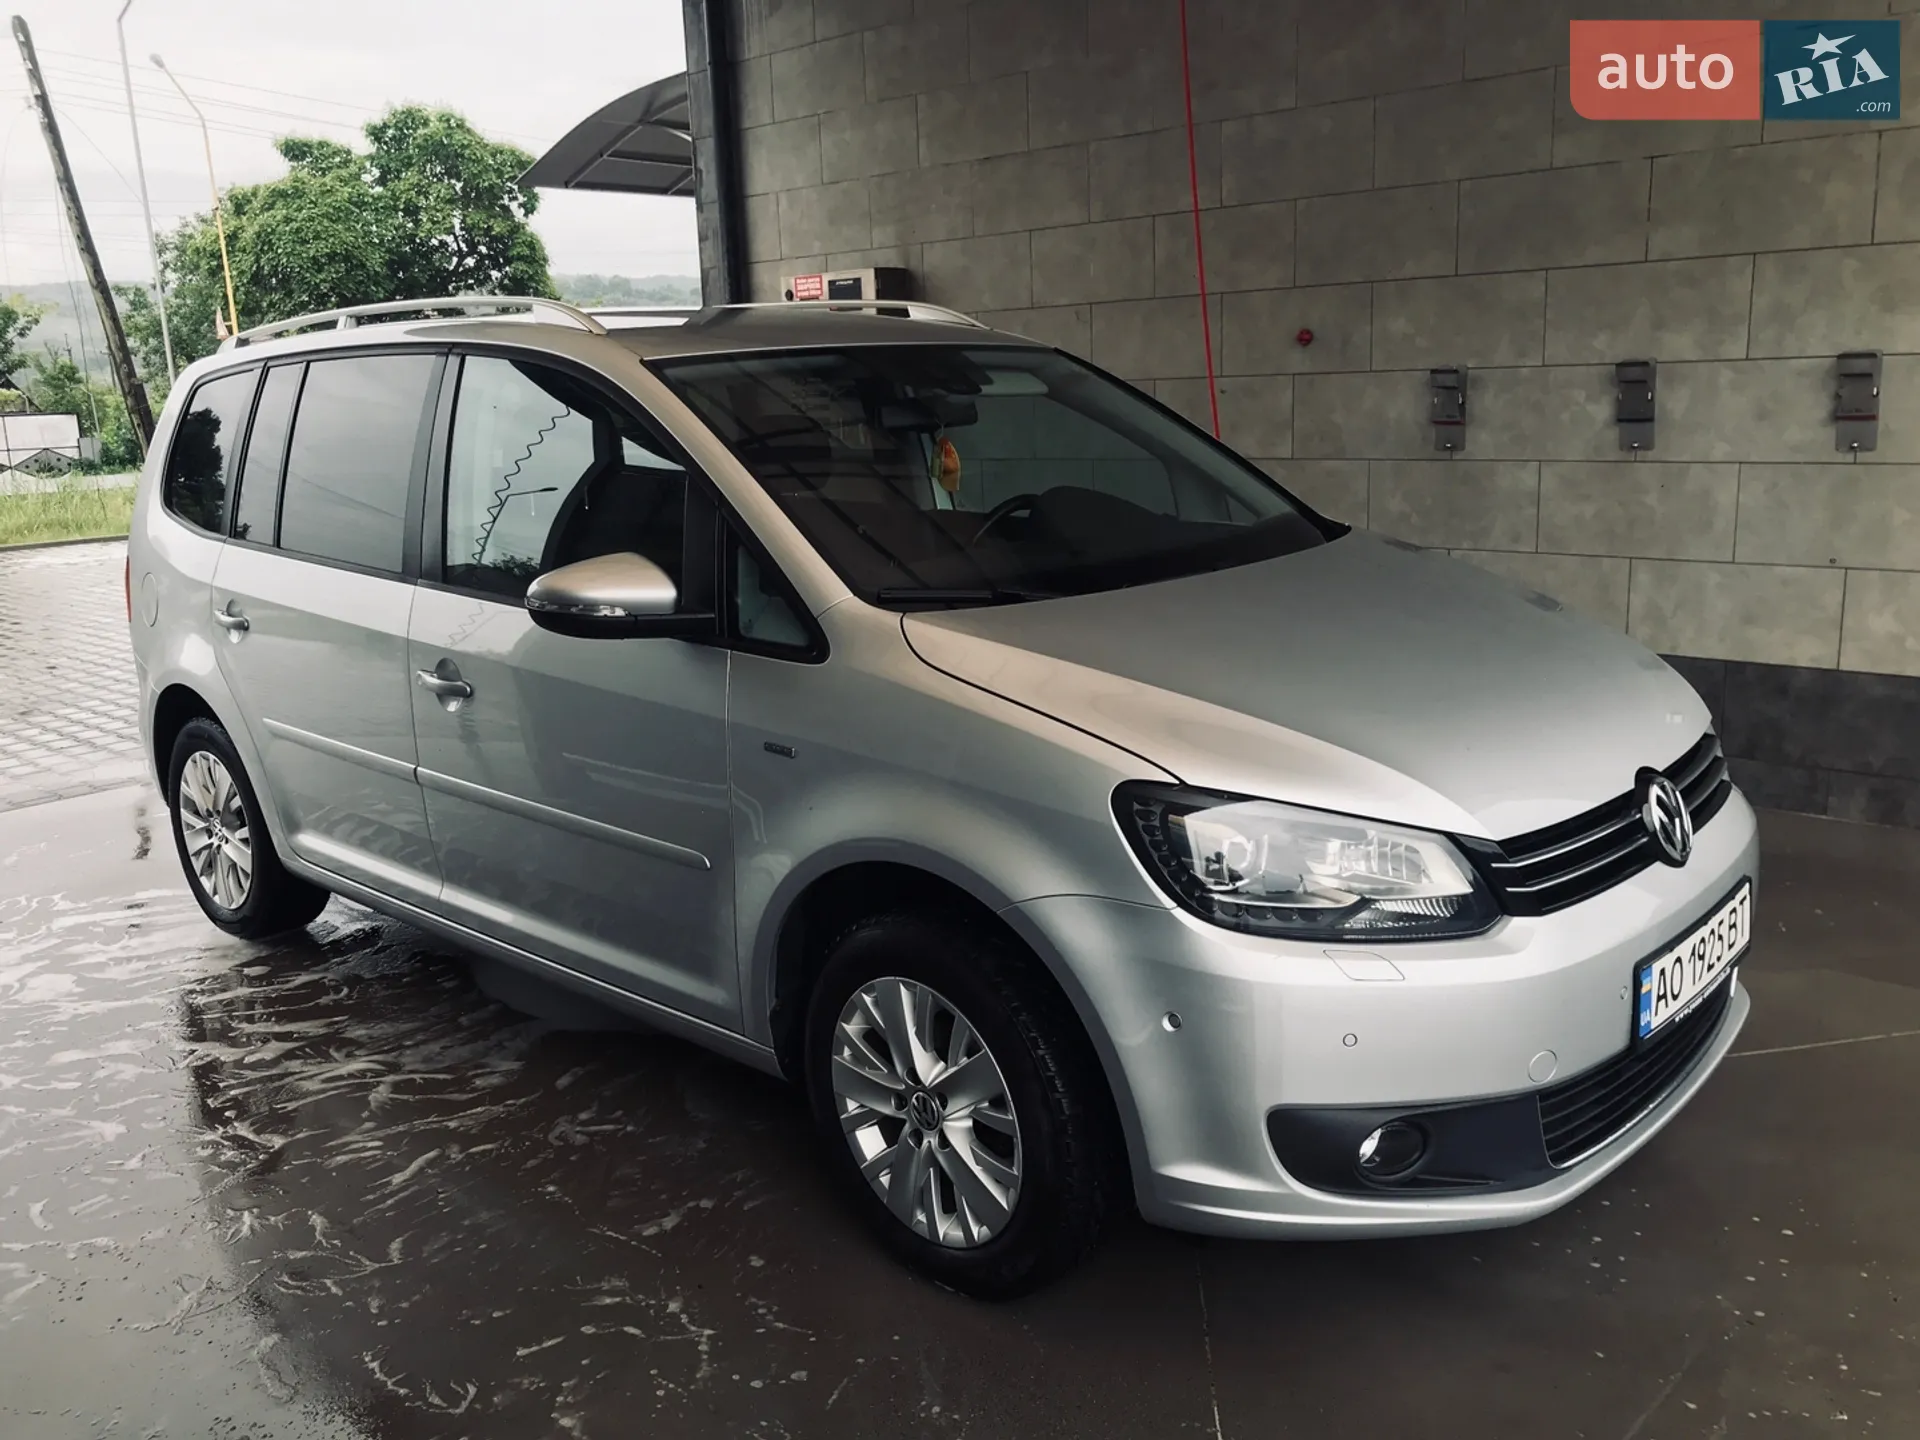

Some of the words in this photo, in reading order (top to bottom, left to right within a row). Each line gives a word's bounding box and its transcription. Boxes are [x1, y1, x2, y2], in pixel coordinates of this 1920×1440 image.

[1654, 956, 1683, 1016] AO
[1688, 919, 1724, 986] 1925
[1728, 895, 1747, 951] BT
[1640, 1009, 1651, 1026] UA
